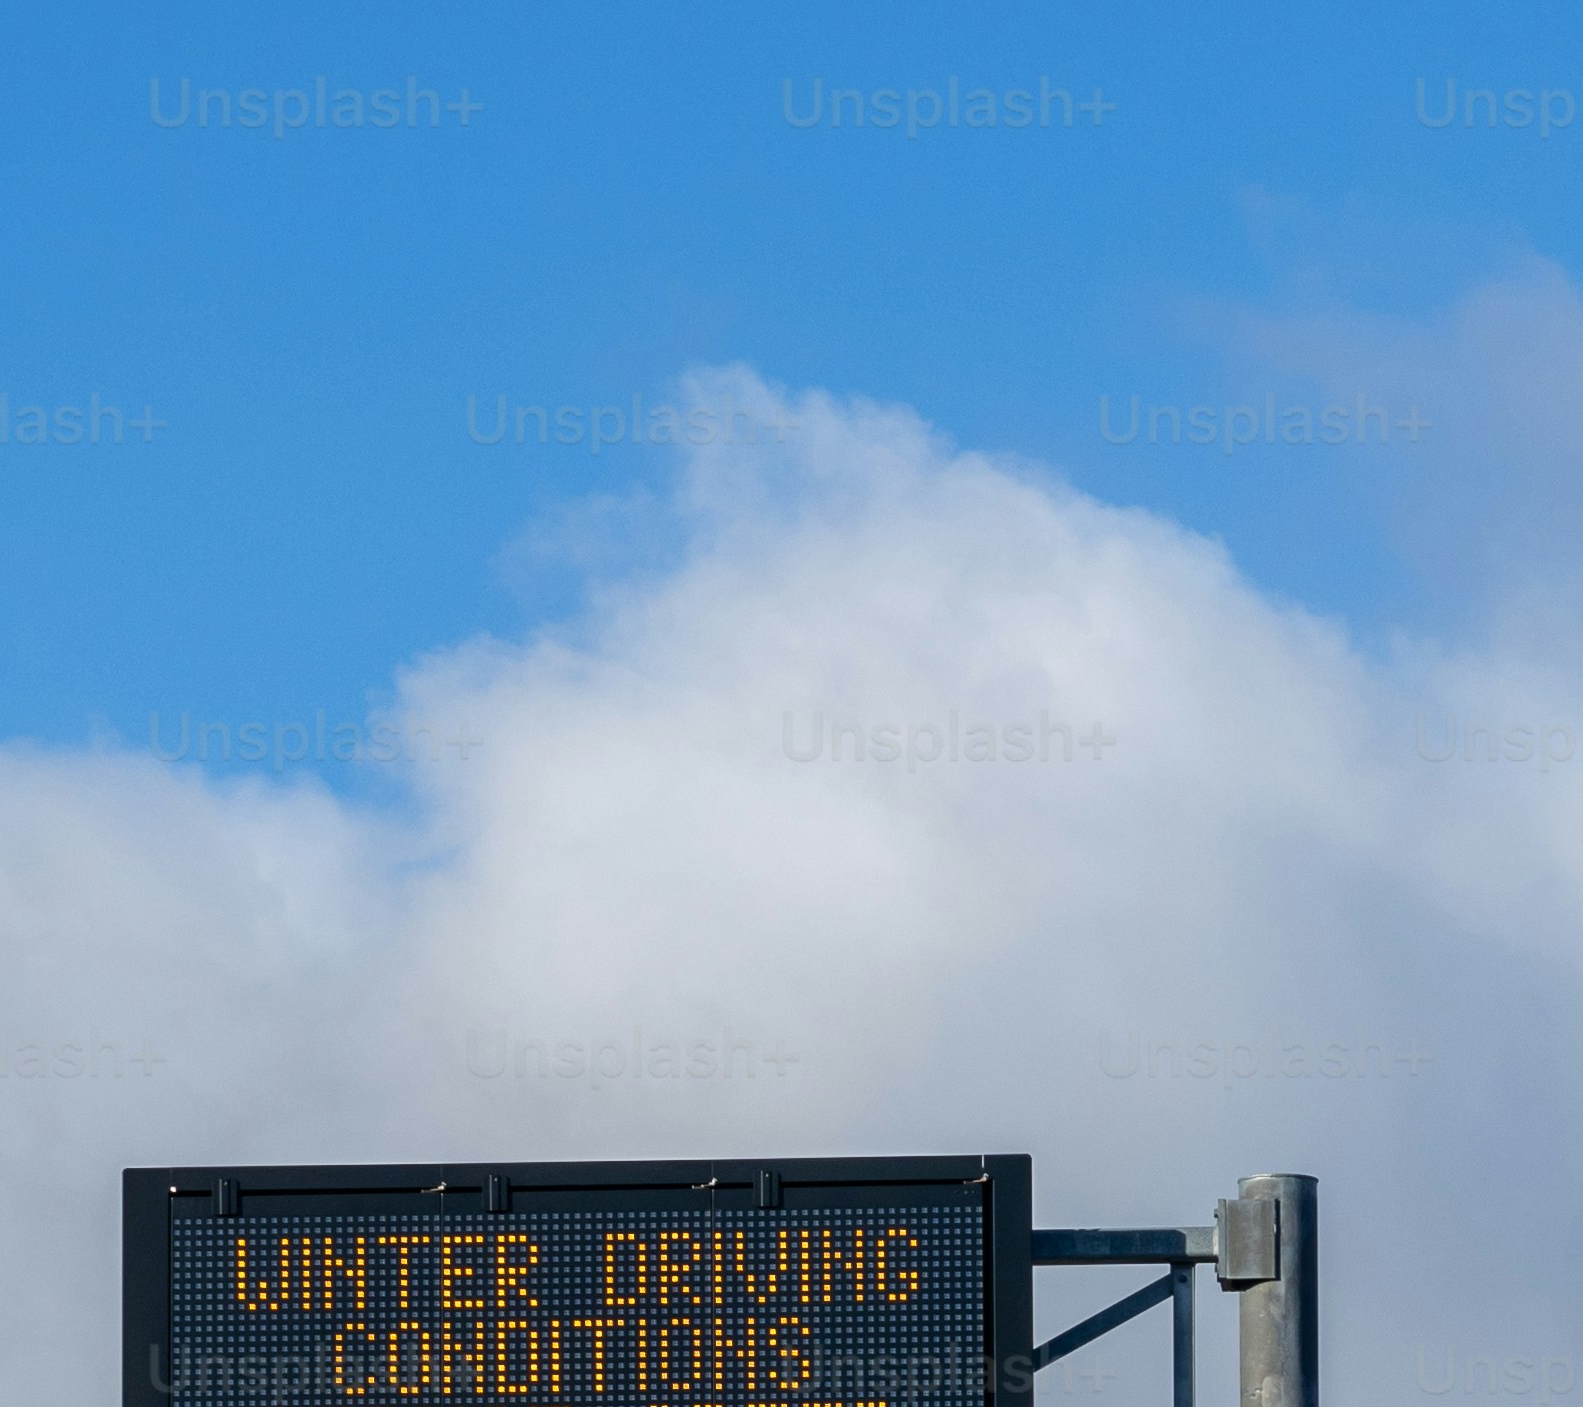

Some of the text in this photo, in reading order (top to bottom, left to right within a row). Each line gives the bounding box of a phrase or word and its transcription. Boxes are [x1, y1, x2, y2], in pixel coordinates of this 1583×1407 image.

[237, 1229, 919, 1311] WINTER DRIVING
[335, 1317, 811, 1395] CONDITIONS
